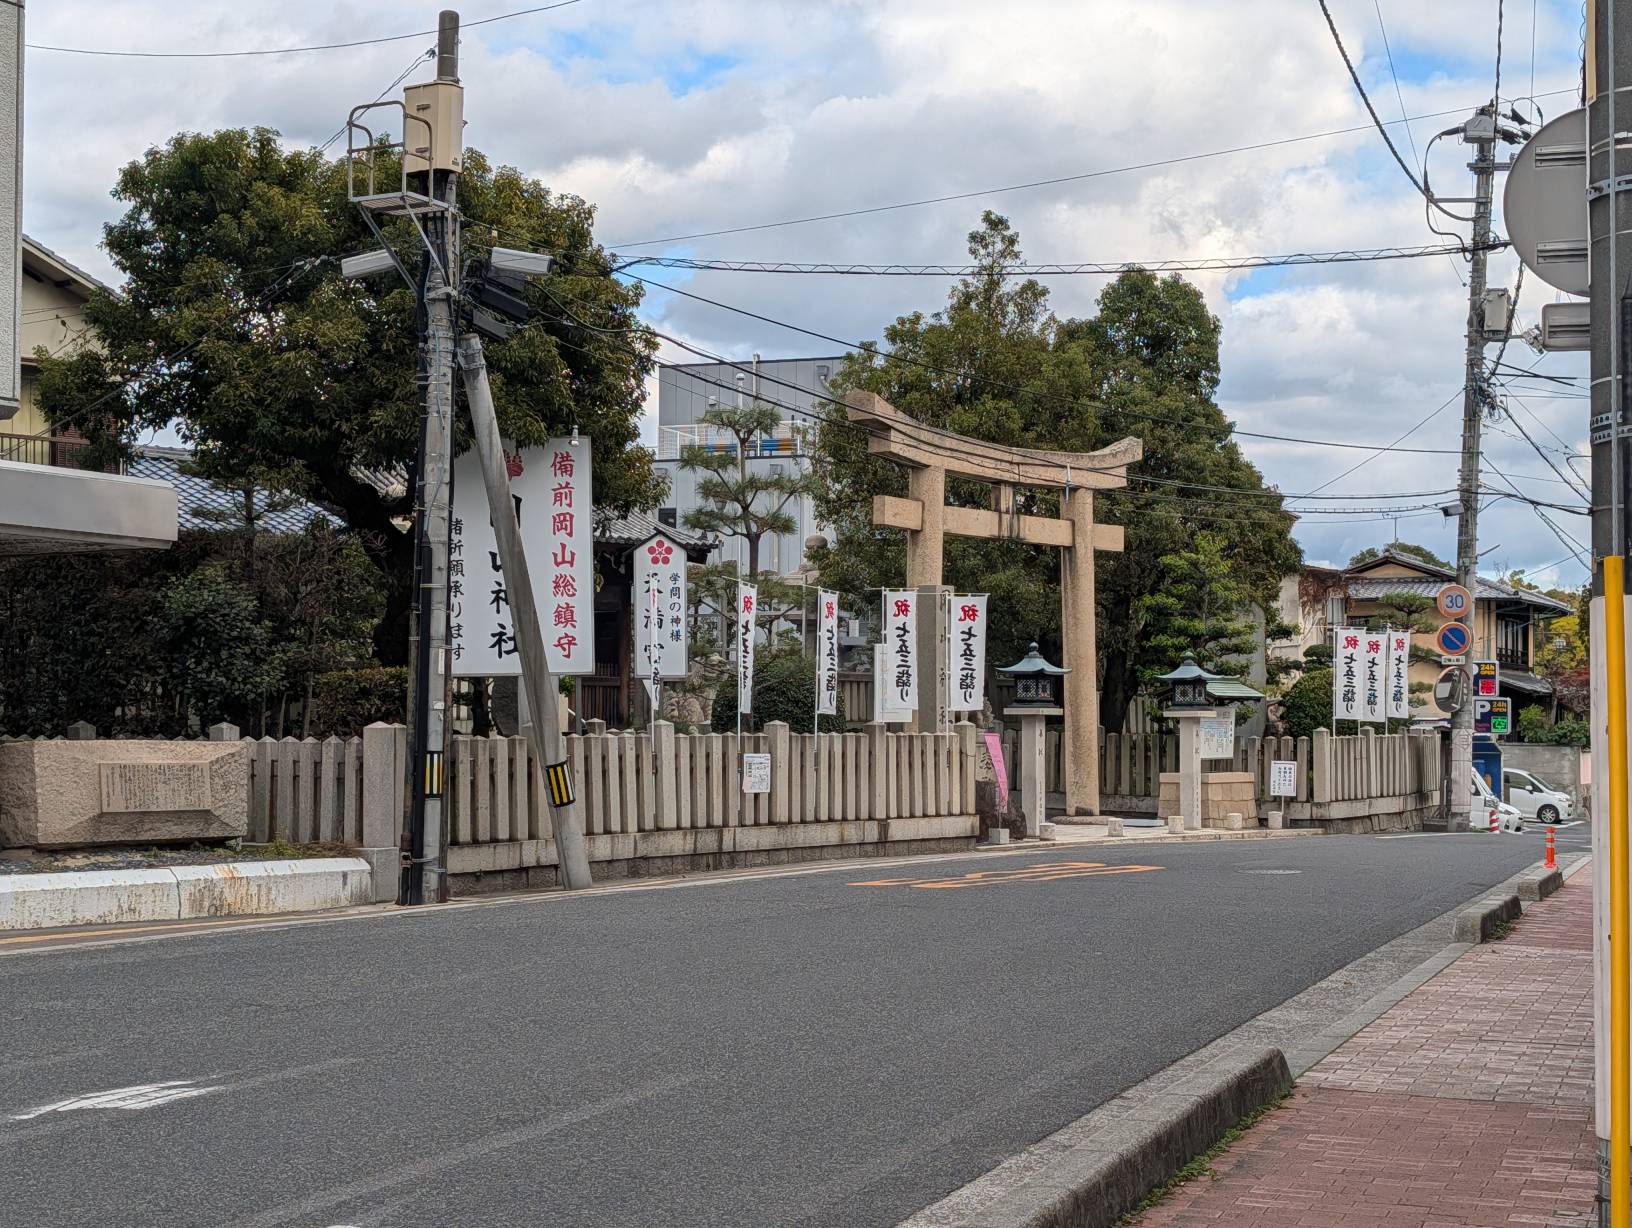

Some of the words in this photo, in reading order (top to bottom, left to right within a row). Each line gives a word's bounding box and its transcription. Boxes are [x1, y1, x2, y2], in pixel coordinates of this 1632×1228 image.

[551, 451, 578, 659] 備前岡山総鎮守
[669, 572, 682, 642] 学問の神様
[1445, 594, 1464, 609] 30
[1475, 700, 1491, 719] P
